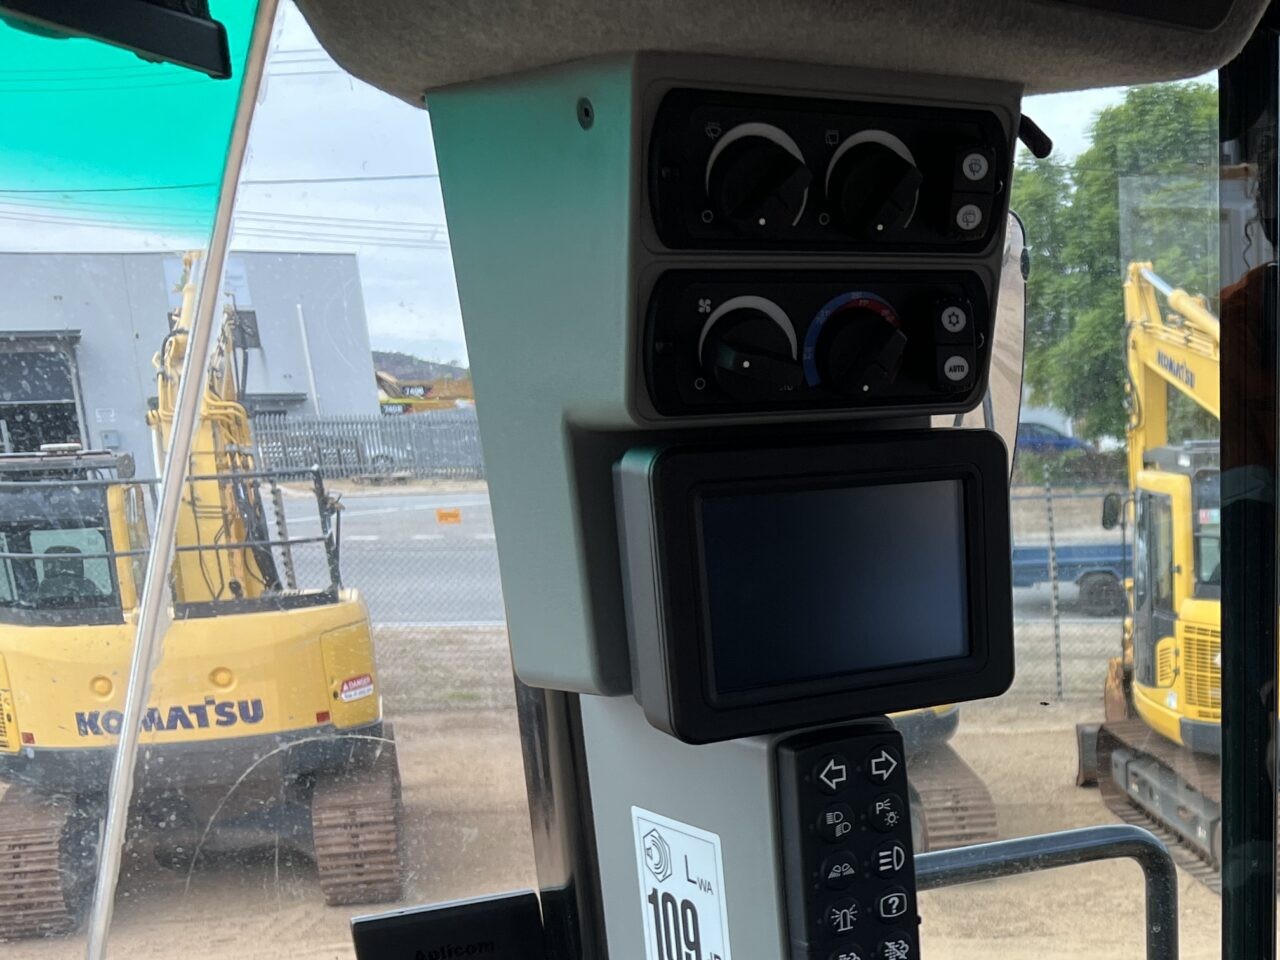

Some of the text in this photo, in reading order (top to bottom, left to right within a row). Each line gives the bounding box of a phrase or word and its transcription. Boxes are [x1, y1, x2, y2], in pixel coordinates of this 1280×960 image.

[948, 364, 965, 373] AUTO
[1157, 350, 1195, 389] KOMATSU
[74, 696, 265, 737] KOMATSU
